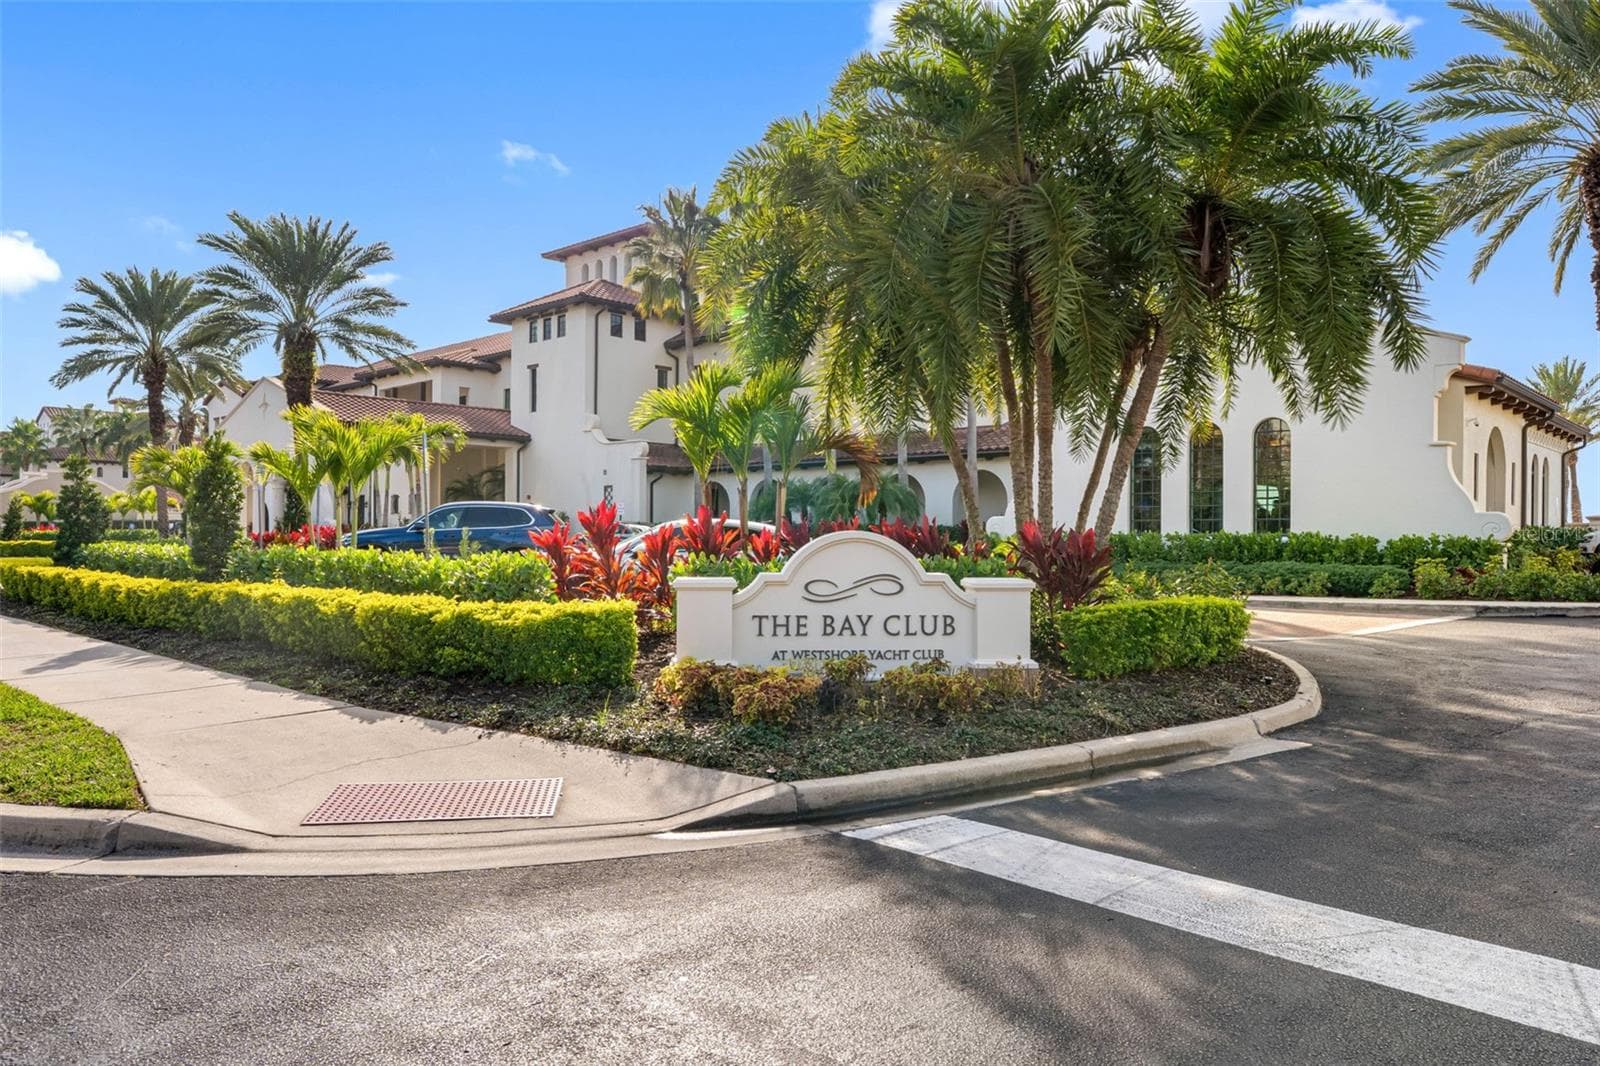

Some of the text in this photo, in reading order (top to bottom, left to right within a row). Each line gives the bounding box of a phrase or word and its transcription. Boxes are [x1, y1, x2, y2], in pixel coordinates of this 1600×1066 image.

[752, 615, 956, 637] THE BAY CLUB
[771, 650, 788, 661] AT
[868, 649, 910, 661] YACHT
[912, 649, 945, 660] CLUB
